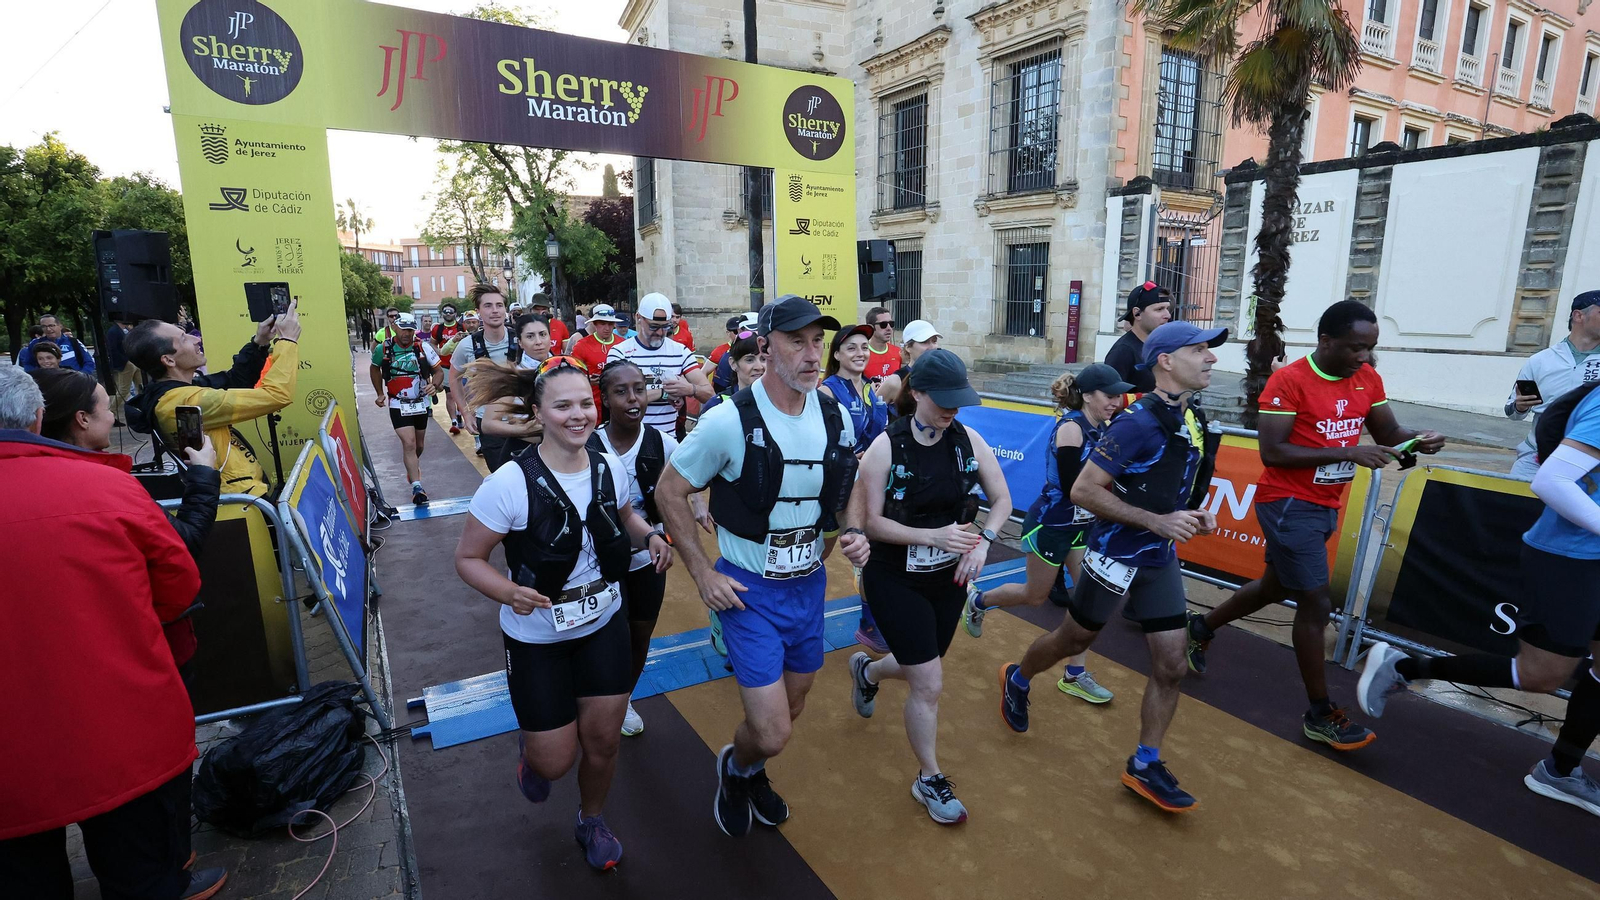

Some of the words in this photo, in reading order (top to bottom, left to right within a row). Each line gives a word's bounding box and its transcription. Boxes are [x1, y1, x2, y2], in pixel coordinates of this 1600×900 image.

[192, 35, 293, 75] Sherry
[212, 57, 280, 76] Maratón
[496, 57, 649, 124] Sherry
[527, 97, 628, 128] Maratón
[788, 112, 841, 138] Sherry
[797, 127, 833, 140] Maratón
[234, 138, 306, 151] Ayuntamiento
[235, 147, 248, 157] de
[250, 148, 277, 158] Jerez
[252, 188, 312, 201] Diputación
[805, 183, 845, 193] Ayuntamiento
[254, 203, 269, 213] de
[272, 203, 303, 214] Cádiz
[812, 218, 845, 228] Diputación
[813, 229, 821, 237] de
[822, 229, 839, 238] Cádiz
[804, 295, 832, 306] HSN
[1315, 417, 1366, 434] Sherry
[787, 543, 812, 564] 173
[577, 595, 599, 615] 79
